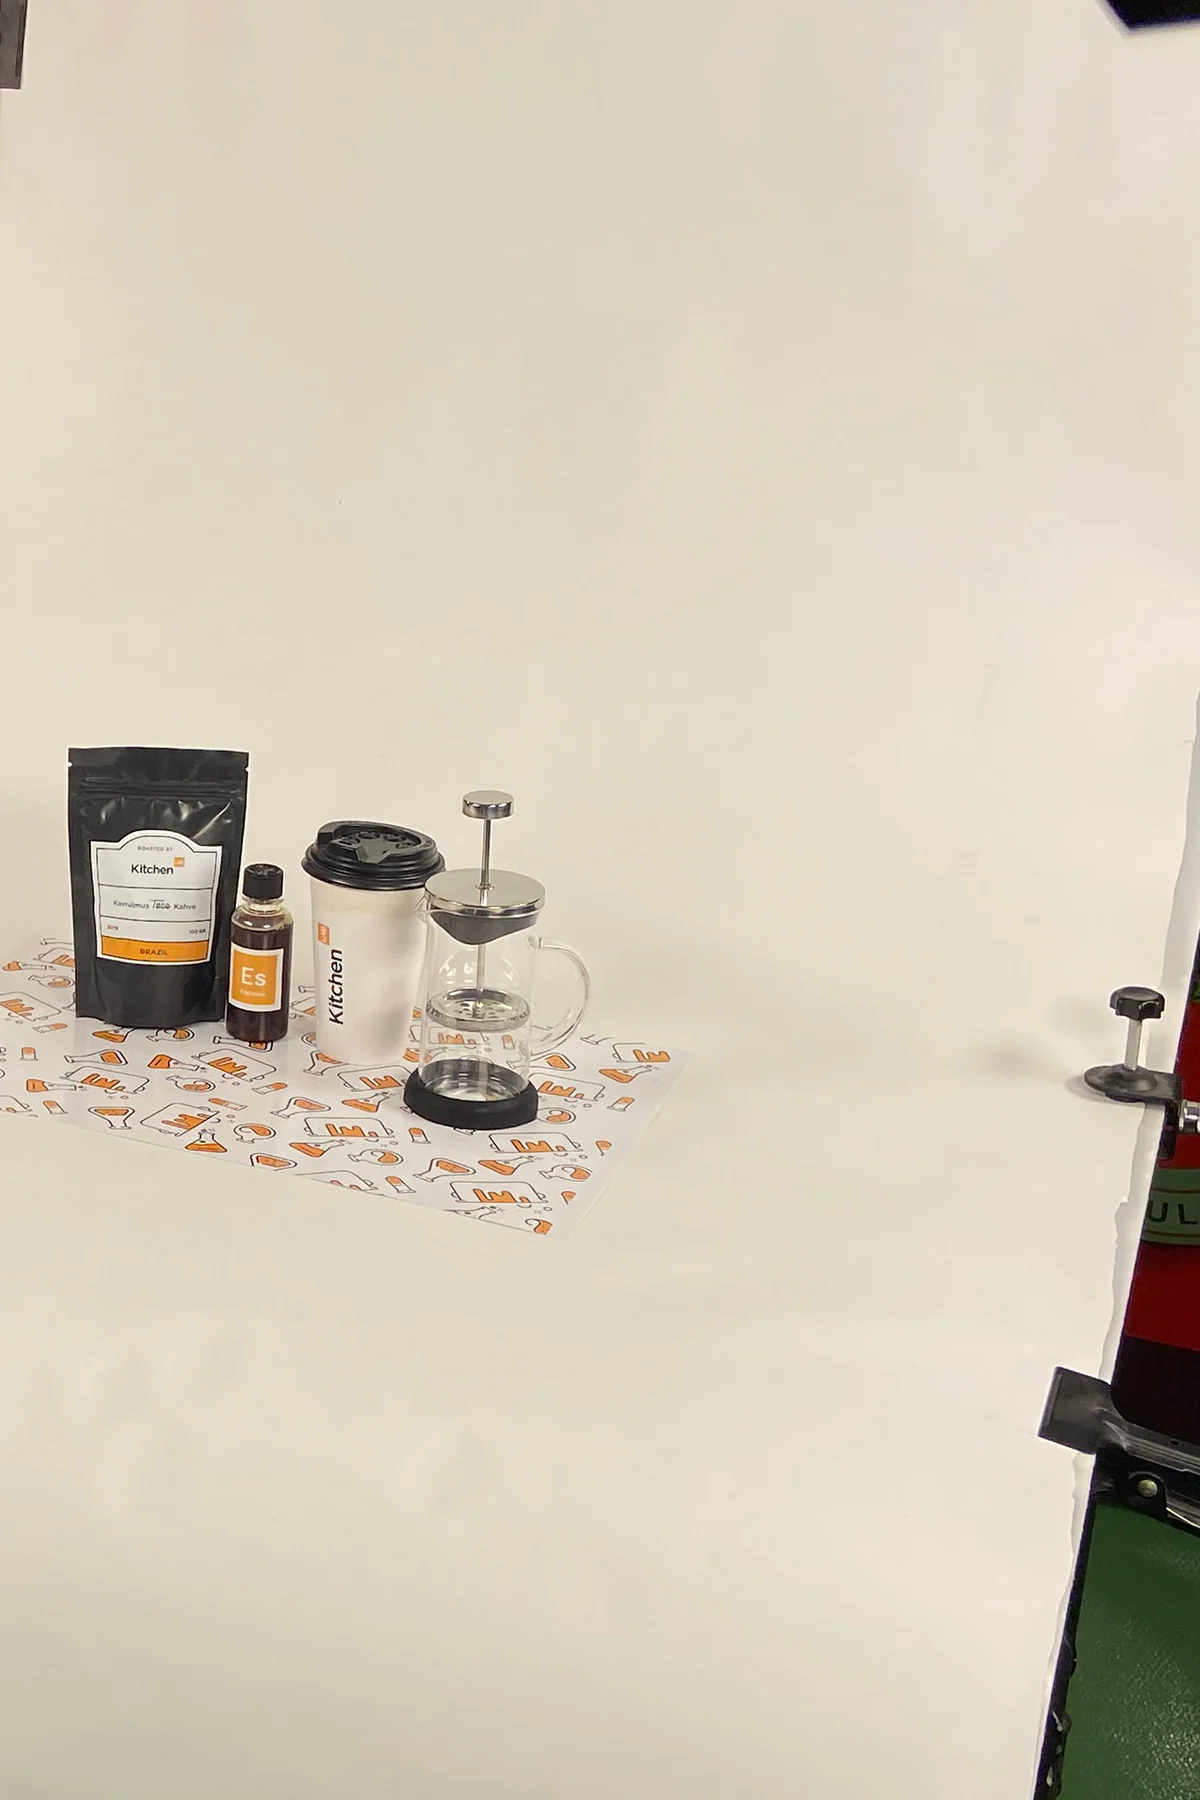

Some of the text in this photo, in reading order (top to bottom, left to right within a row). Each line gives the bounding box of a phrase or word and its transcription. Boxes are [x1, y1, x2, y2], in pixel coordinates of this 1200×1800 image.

[131, 864, 174, 875] Kitchen
[140, 948, 169, 956] BRAZIL
[241, 966, 267, 987] Es
[328, 948, 344, 1025] Kitchen
